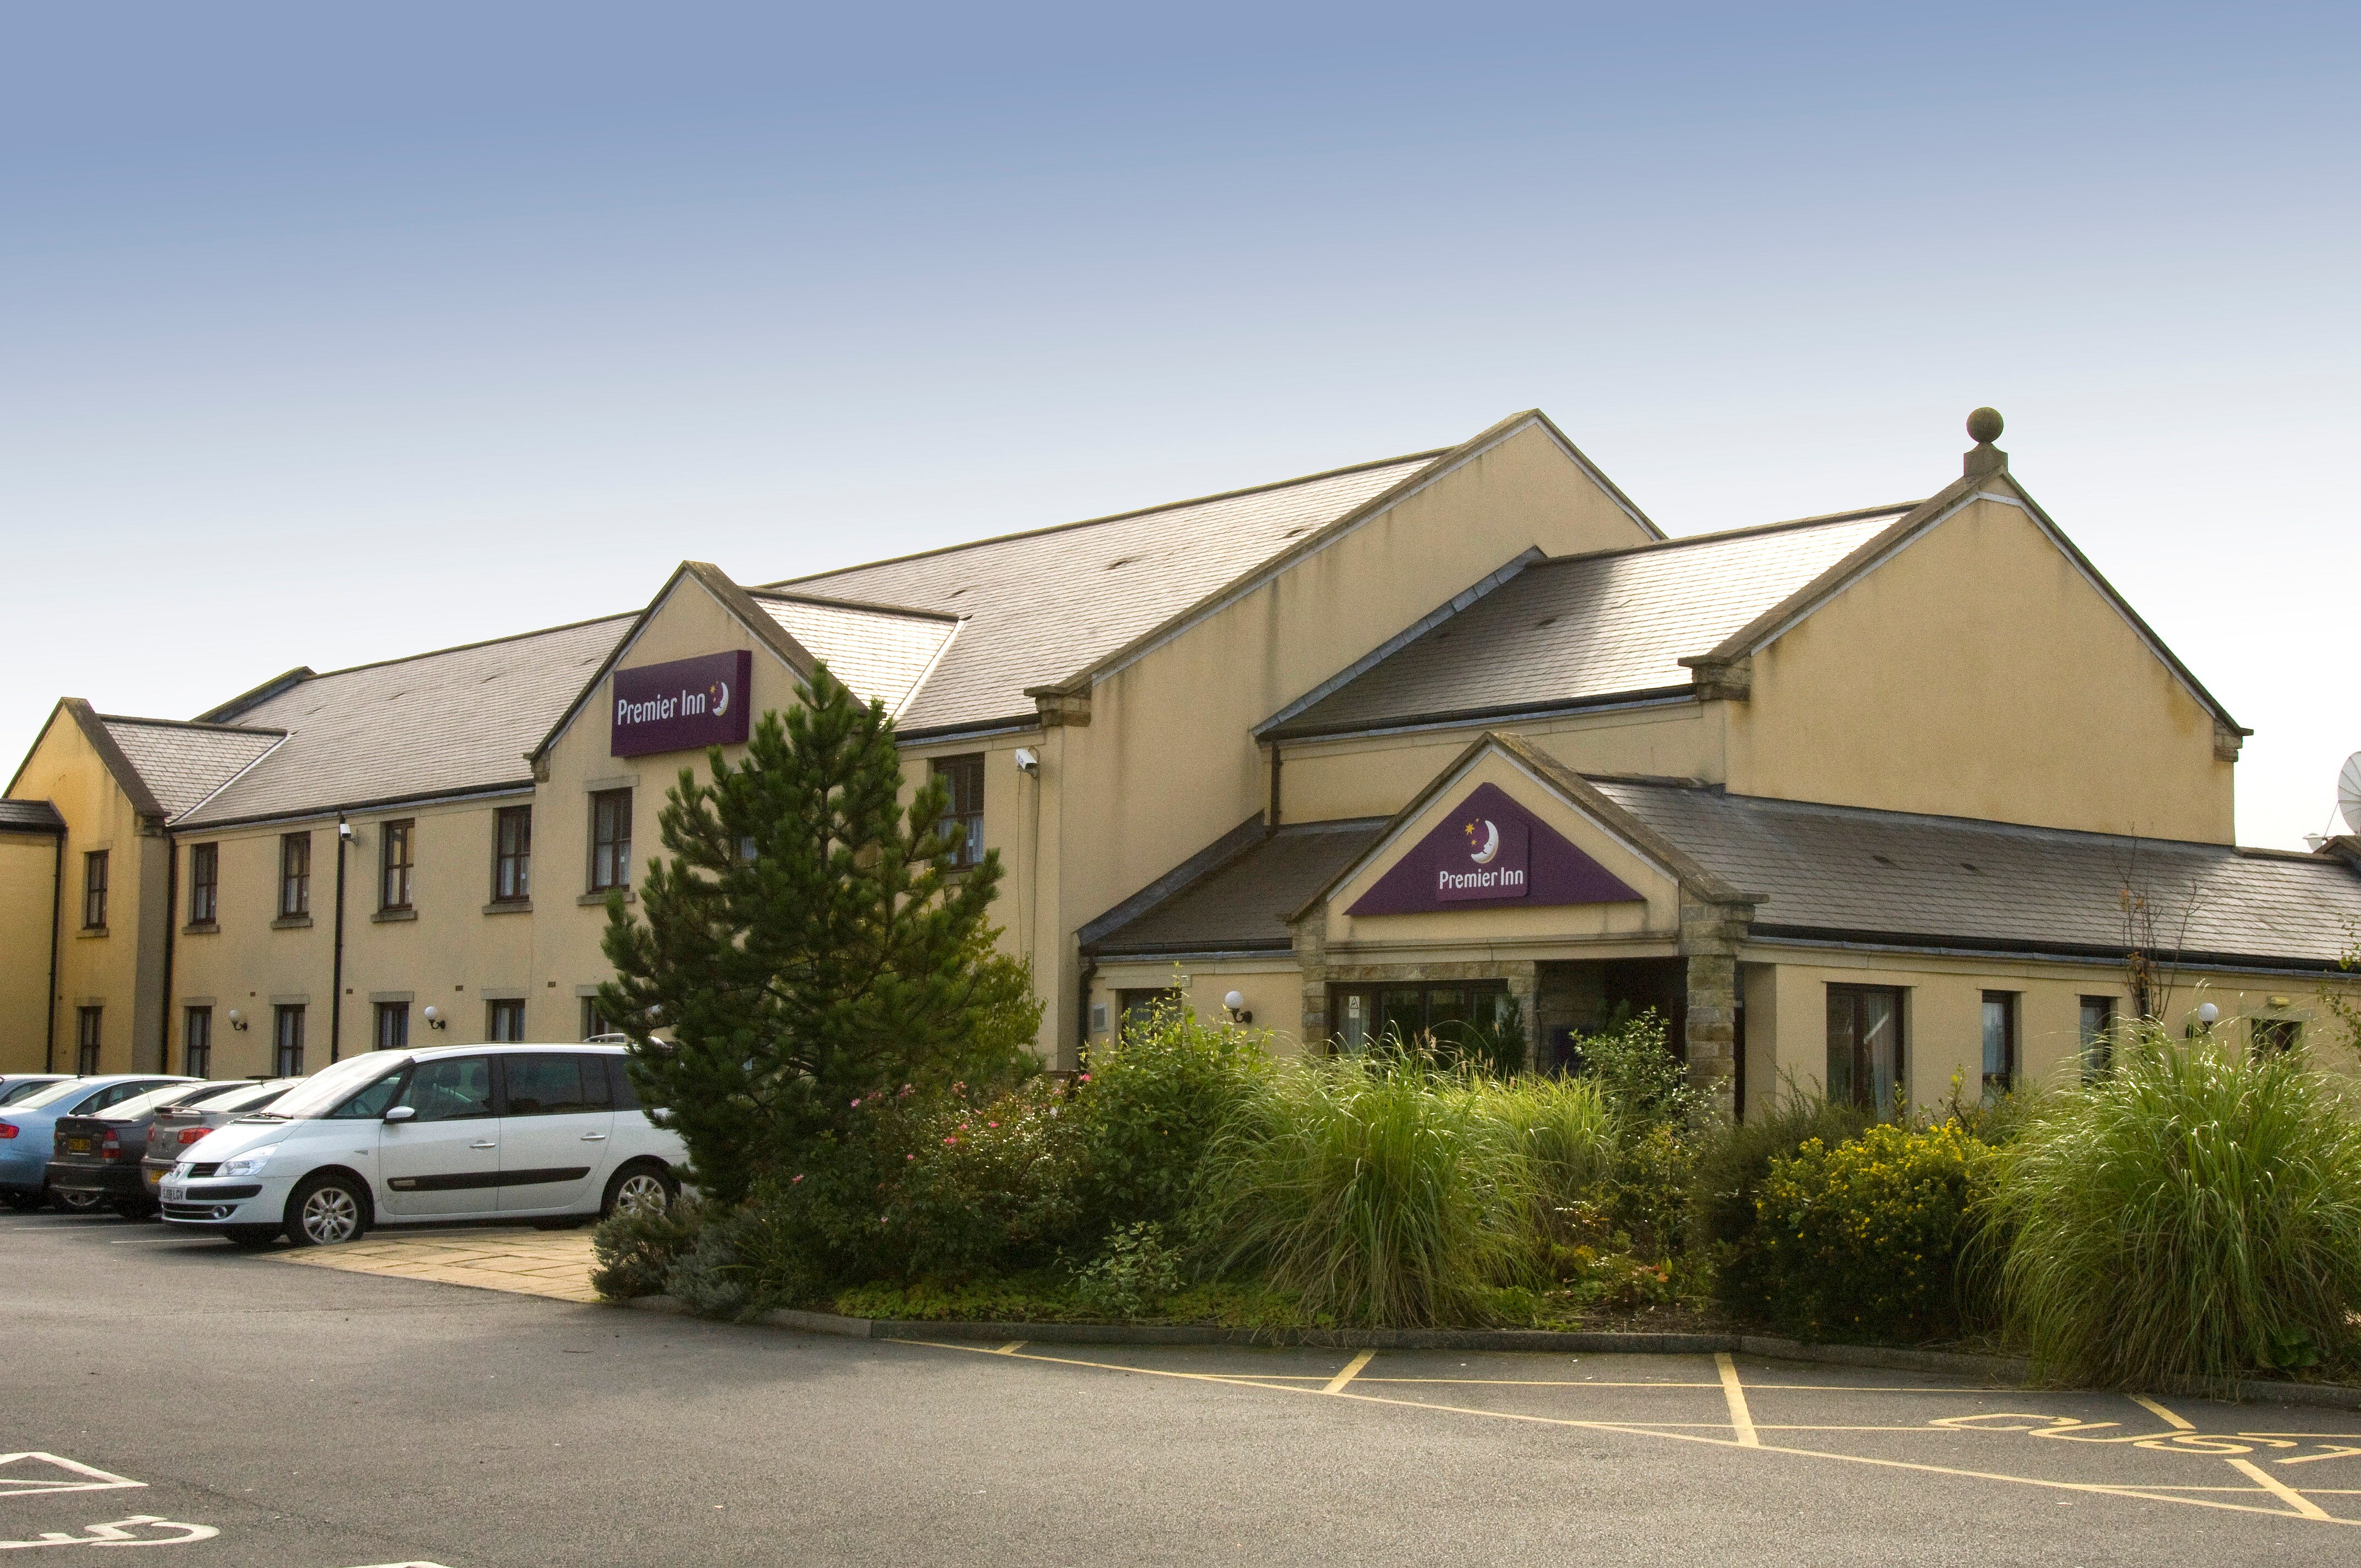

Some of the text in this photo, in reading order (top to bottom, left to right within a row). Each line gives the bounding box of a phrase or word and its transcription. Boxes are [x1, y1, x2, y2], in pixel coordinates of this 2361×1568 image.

[617, 690, 705, 725] Premier Inn
[1439, 867, 1524, 890] Premier Inn
